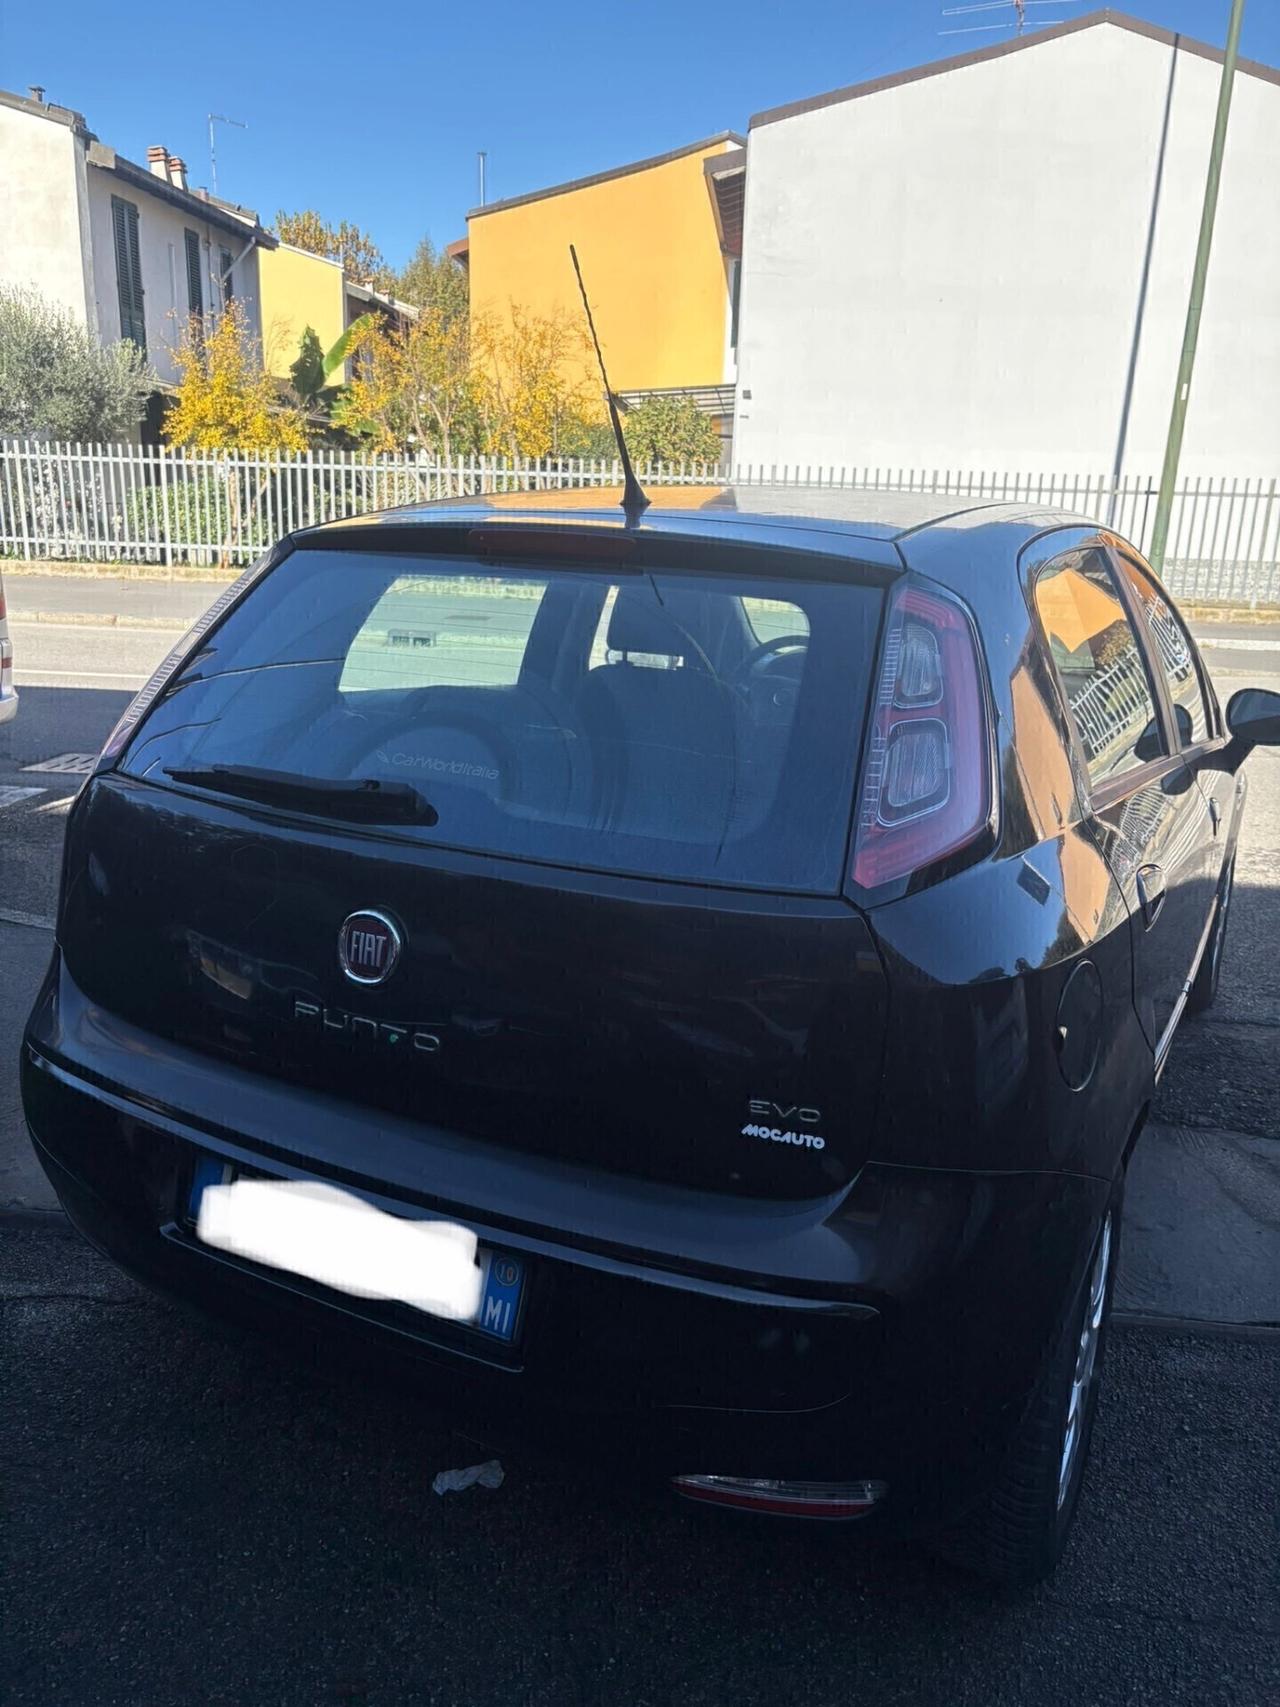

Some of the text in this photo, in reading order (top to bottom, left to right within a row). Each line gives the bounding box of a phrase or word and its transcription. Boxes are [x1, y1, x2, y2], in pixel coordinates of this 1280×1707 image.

[350, 931, 387, 968] FIAT
[750, 1100, 821, 1122] EVO
[741, 1123, 825, 1150] MOCAUTO
[484, 1295, 511, 1333] MI
